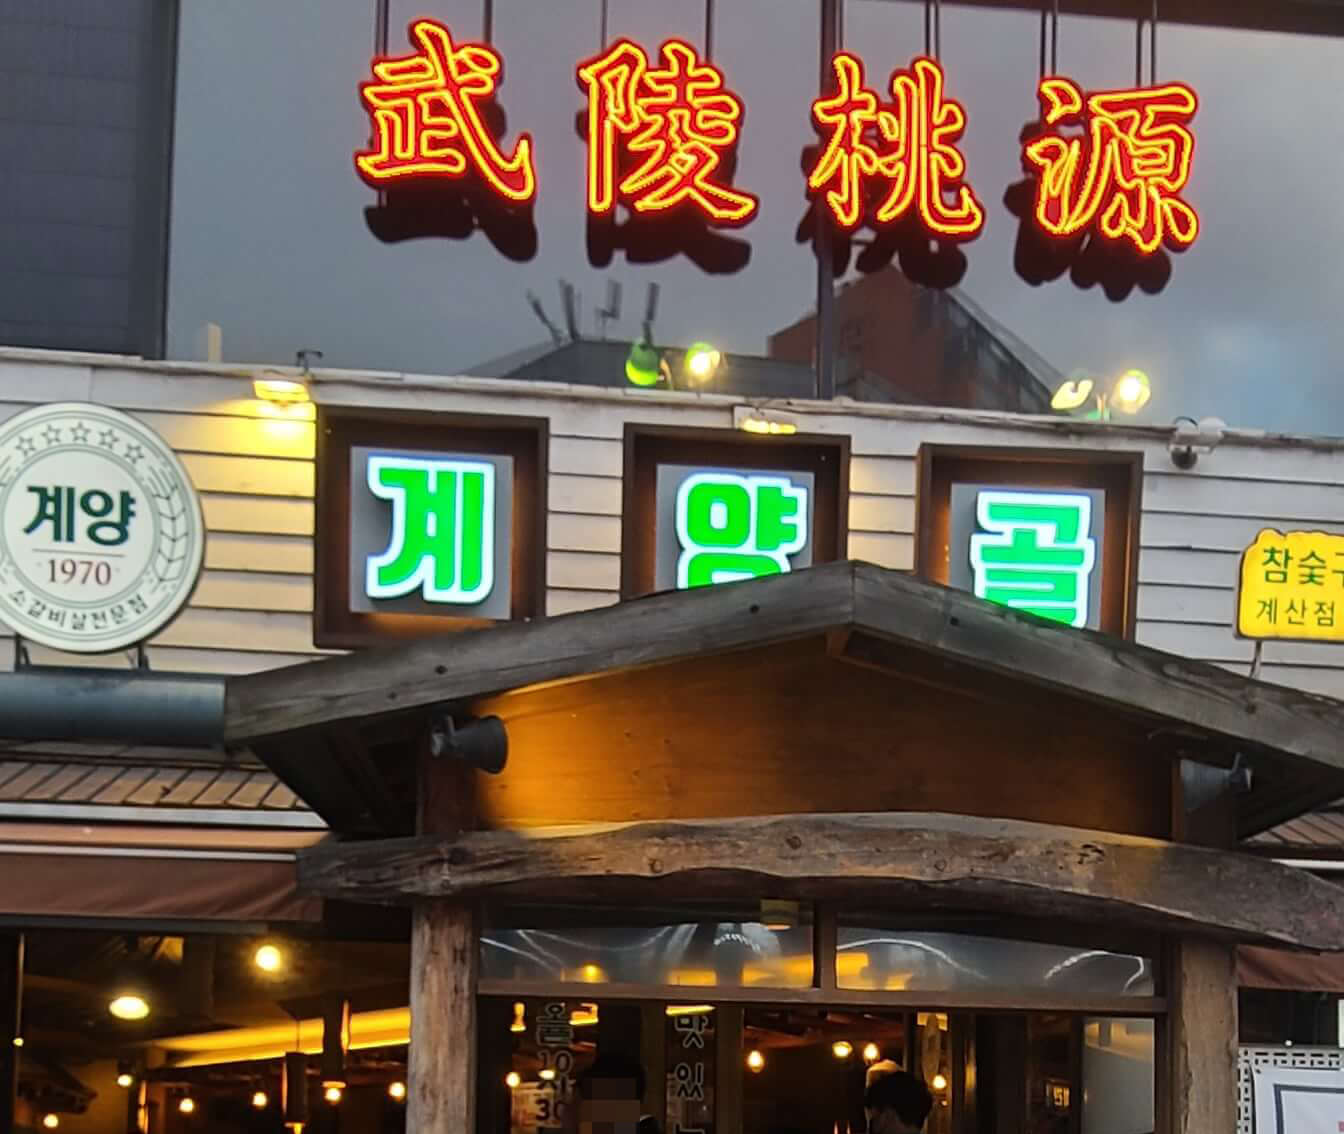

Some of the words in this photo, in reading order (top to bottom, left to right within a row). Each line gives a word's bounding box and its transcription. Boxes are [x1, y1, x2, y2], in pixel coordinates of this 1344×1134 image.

[356, 17, 1201, 255] 武陵桃源
[23, 484, 137, 547] 계양
[47, 558, 113, 586] 1970
[1256, 597, 1337, 628] 계산점
